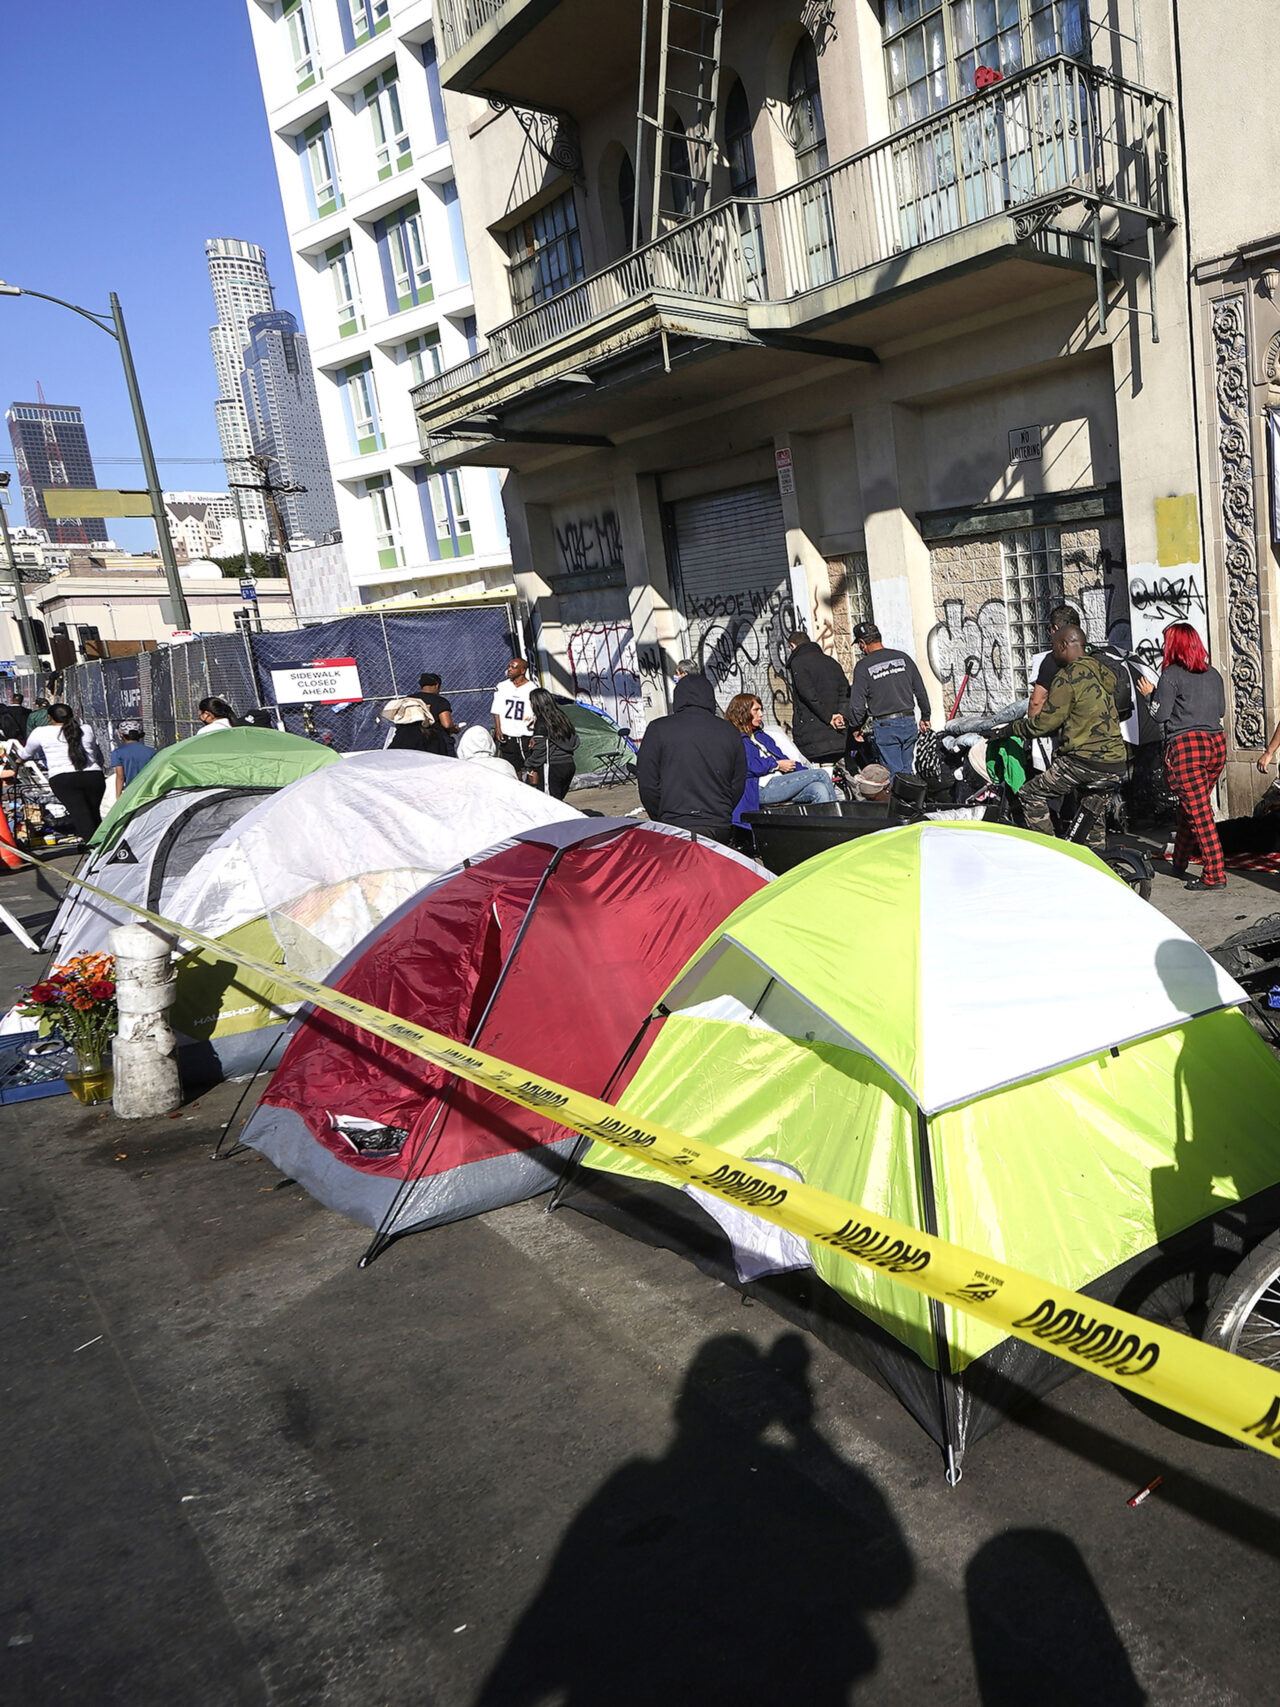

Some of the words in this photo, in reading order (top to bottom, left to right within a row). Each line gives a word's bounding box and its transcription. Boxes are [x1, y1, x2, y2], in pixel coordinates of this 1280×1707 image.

[1020, 430, 1030, 444] NO
[1011, 443, 1040, 460] LOITERING
[290, 670, 341, 681] SIDEWALK
[297, 679, 337, 688] CLOSED
[302, 687, 336, 696] AHEAD
[504, 699, 525, 721] 28
[193, 1004, 259, 1026] HAUSHOF
[1011, 1298, 1161, 1376] CUIDADO
